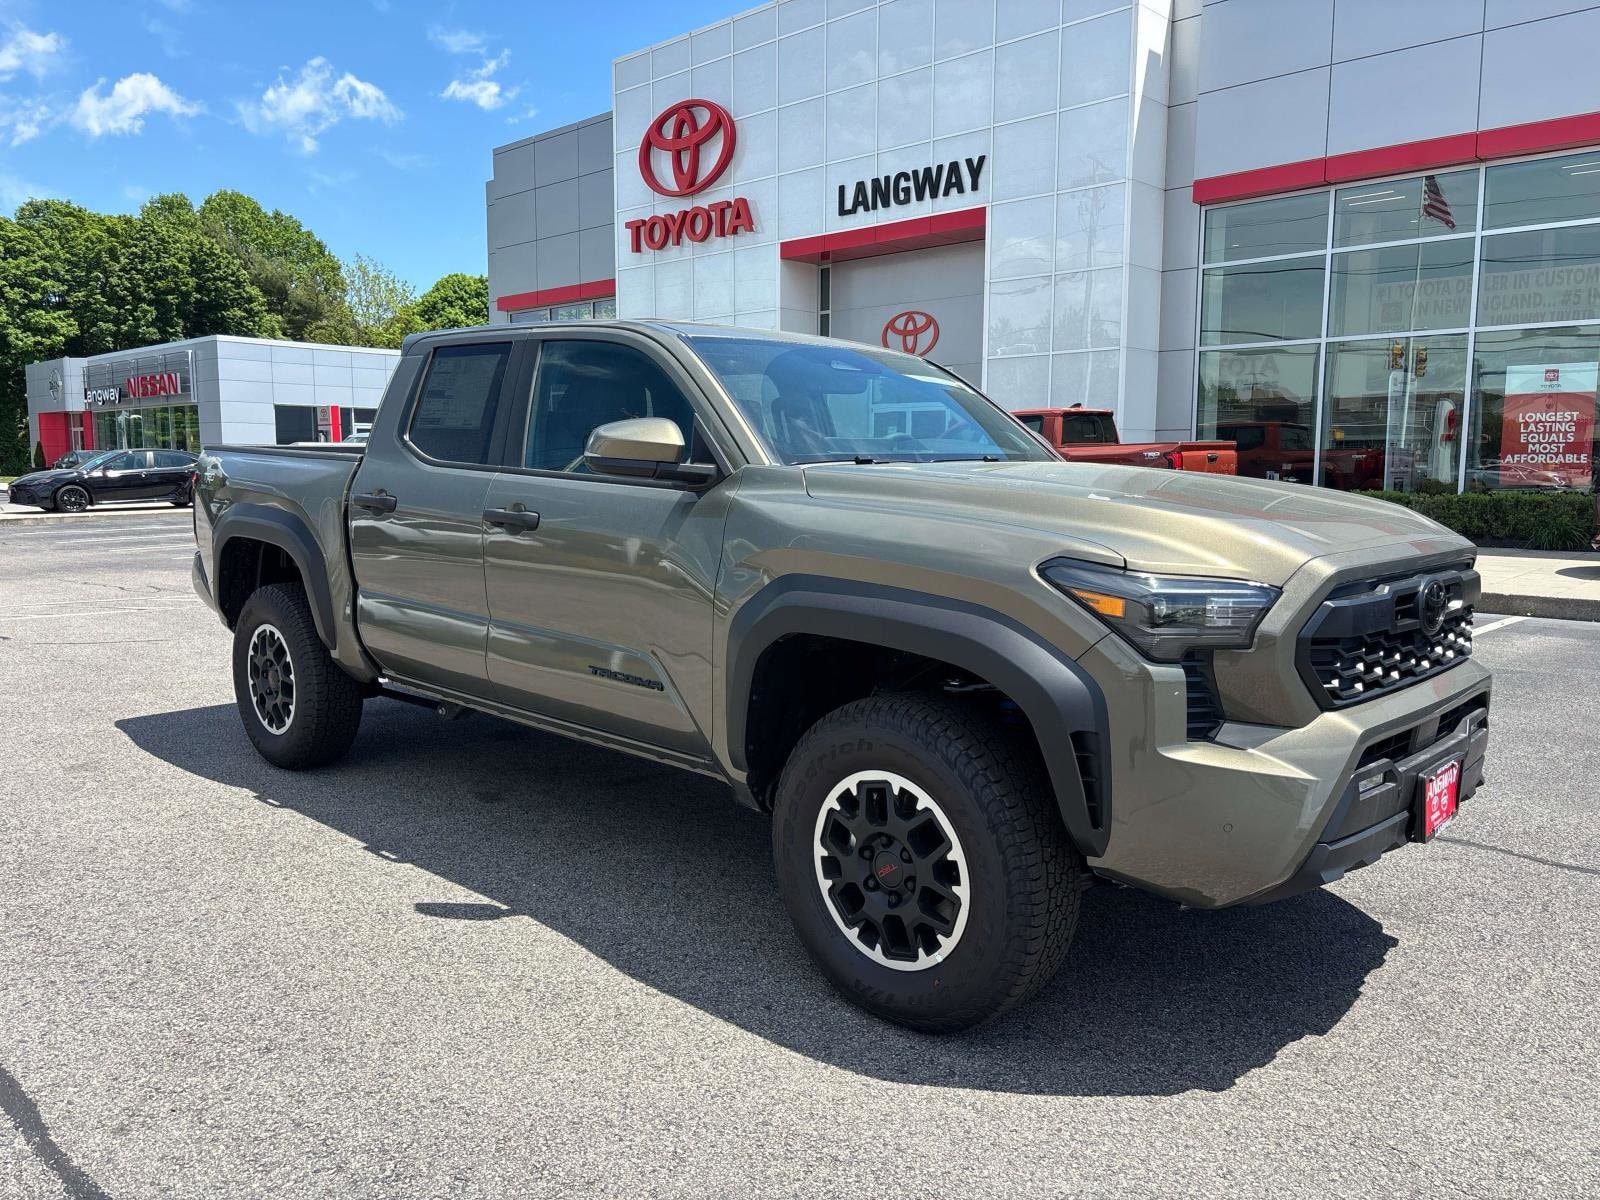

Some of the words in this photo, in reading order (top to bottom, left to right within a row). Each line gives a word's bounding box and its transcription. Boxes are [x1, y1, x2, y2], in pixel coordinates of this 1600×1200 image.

[838, 155, 986, 216] LANGWAY
[625, 197, 755, 253] TOYOTA
[1400, 279, 1450, 299] TOYOTA
[1455, 274, 1508, 294] DELER
[1513, 273, 1530, 290] IN
[1434, 298, 1466, 315] NEW
[1480, 292, 1556, 311] NGLAND...
[1561, 289, 1584, 306] #5
[84, 387, 121, 405] Langway
[127, 372, 181, 398] NISSAN
[1519, 412, 1579, 422] LONGEST
[1520, 423, 1576, 432] LASTING
[1520, 433, 1575, 442] EQUALS
[1528, 443, 1565, 453] MOST
[1504, 454, 1588, 463] AFFORDABLE
[588, 665, 664, 691] TACOMA
